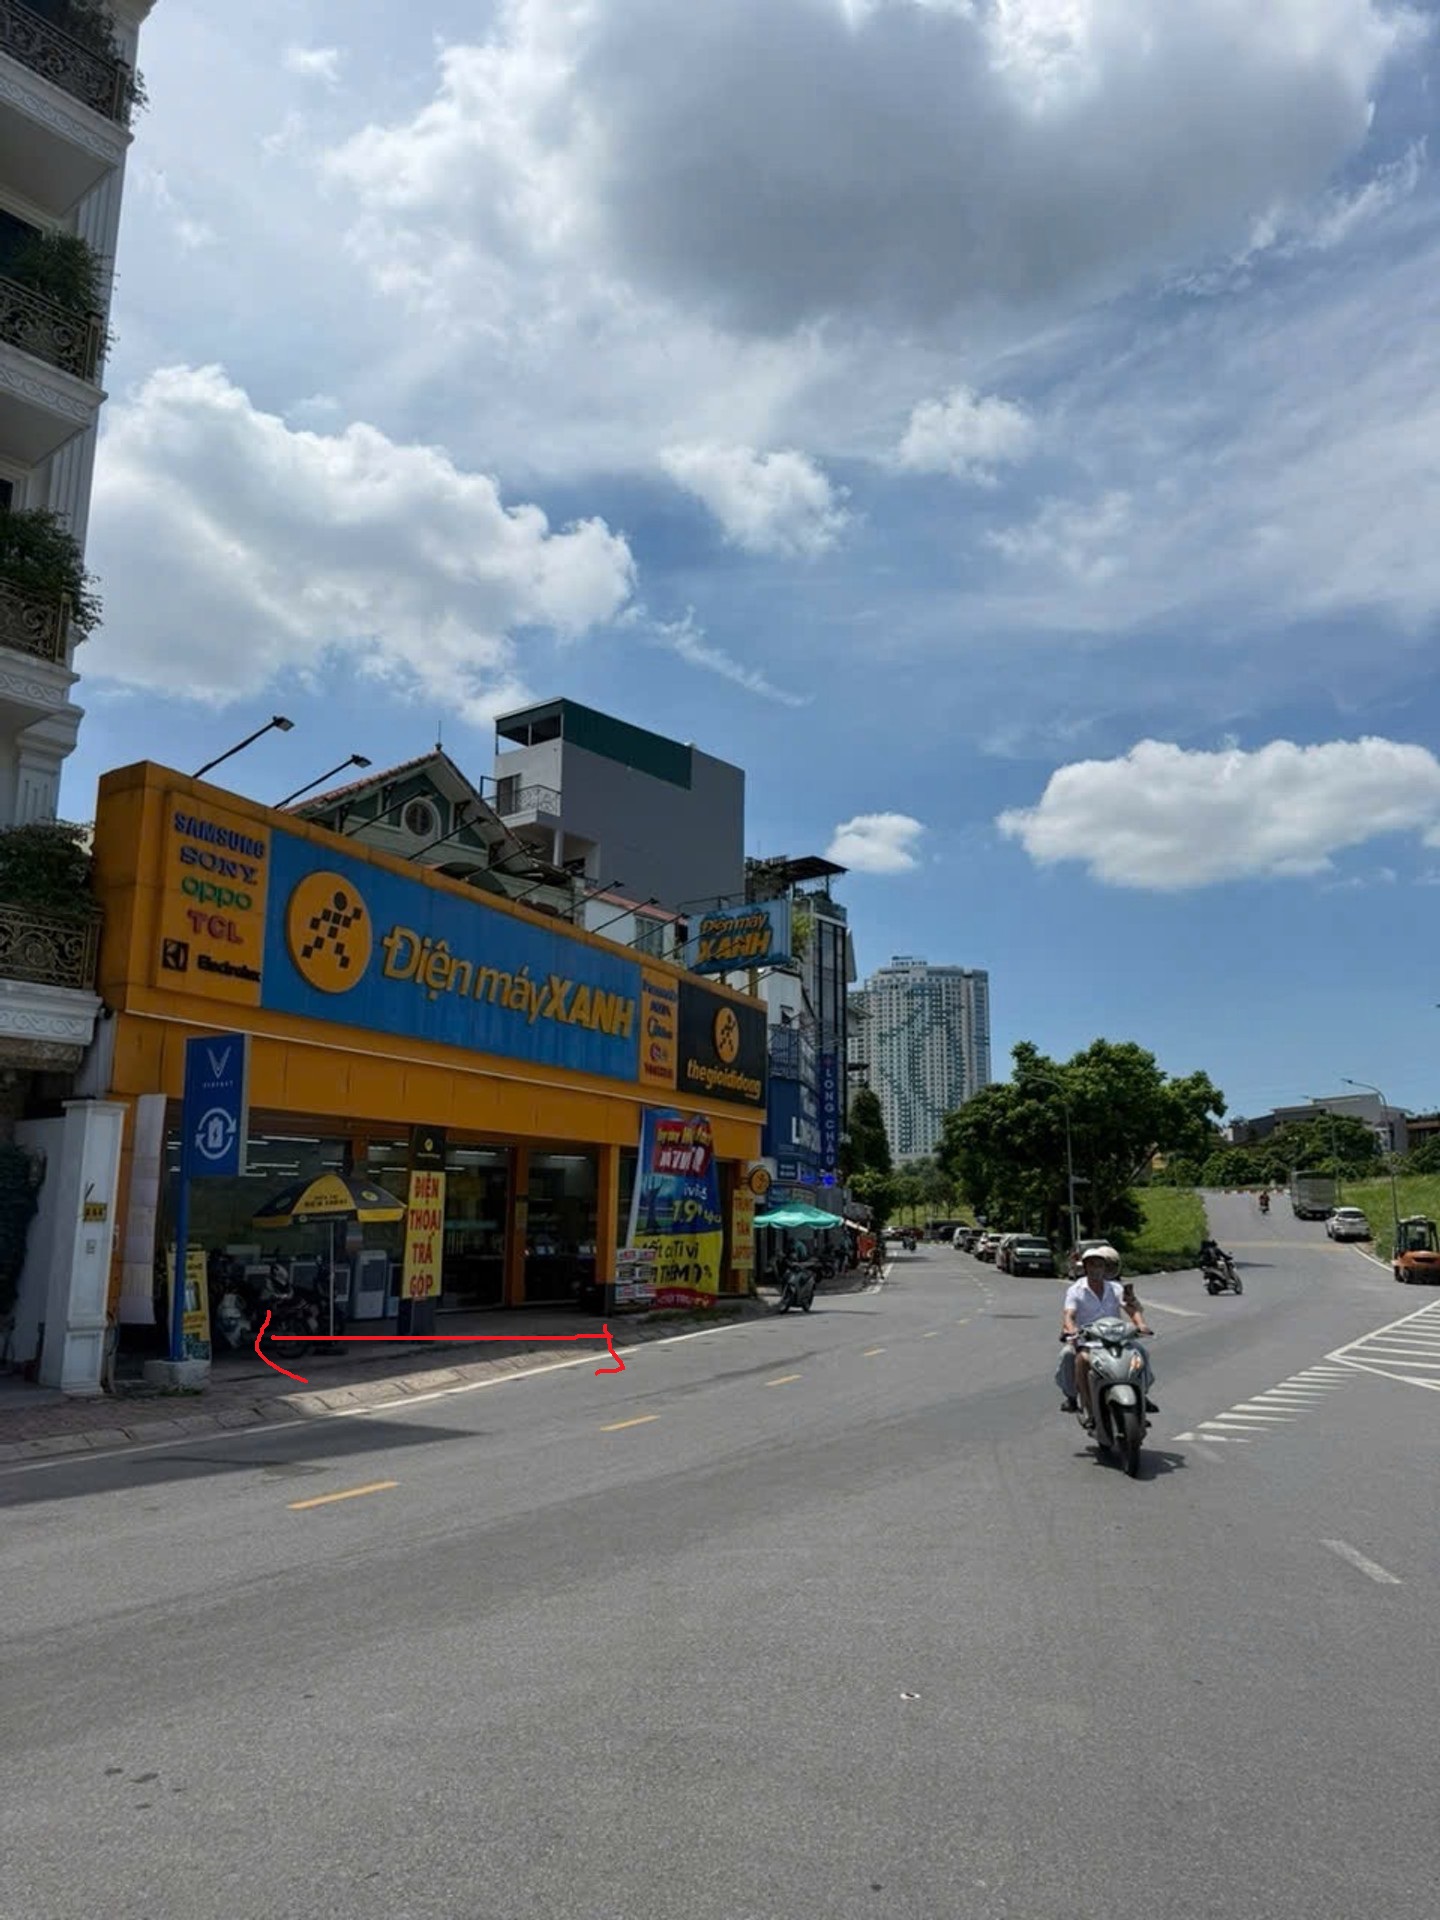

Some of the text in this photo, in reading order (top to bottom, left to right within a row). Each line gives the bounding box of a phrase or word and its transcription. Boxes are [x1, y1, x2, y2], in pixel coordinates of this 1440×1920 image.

[174, 811, 265, 860] SAMSUNG
[180, 845, 258, 887] SONY
[187, 909, 244, 945] TCL
[696, 929, 771, 963] XANH
[381, 925, 473, 1001] Điện
[543, 974, 636, 1040] XANH
